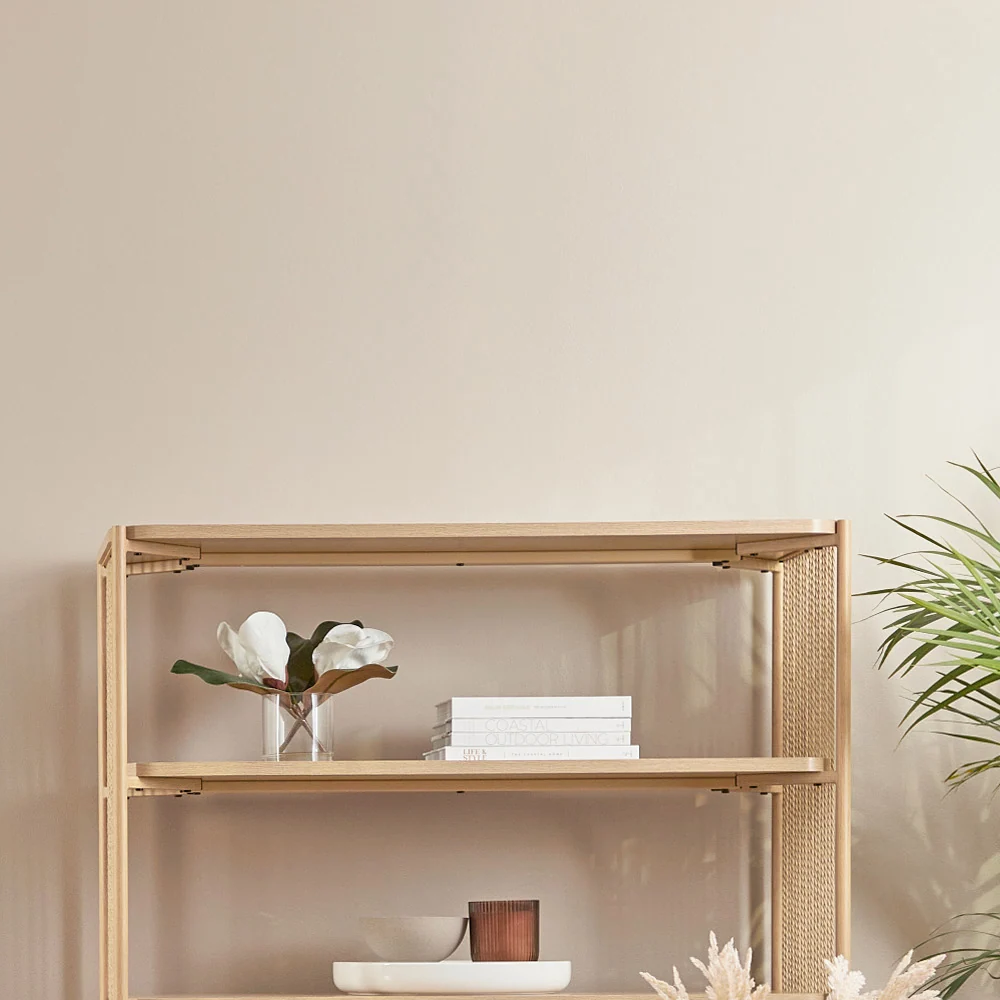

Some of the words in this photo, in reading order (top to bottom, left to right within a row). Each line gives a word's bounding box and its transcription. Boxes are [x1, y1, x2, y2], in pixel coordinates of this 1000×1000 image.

[485, 719, 550, 731] COASTAL
[485, 733, 559, 745] OUTDOOR
[563, 733, 610, 745] LIVING
